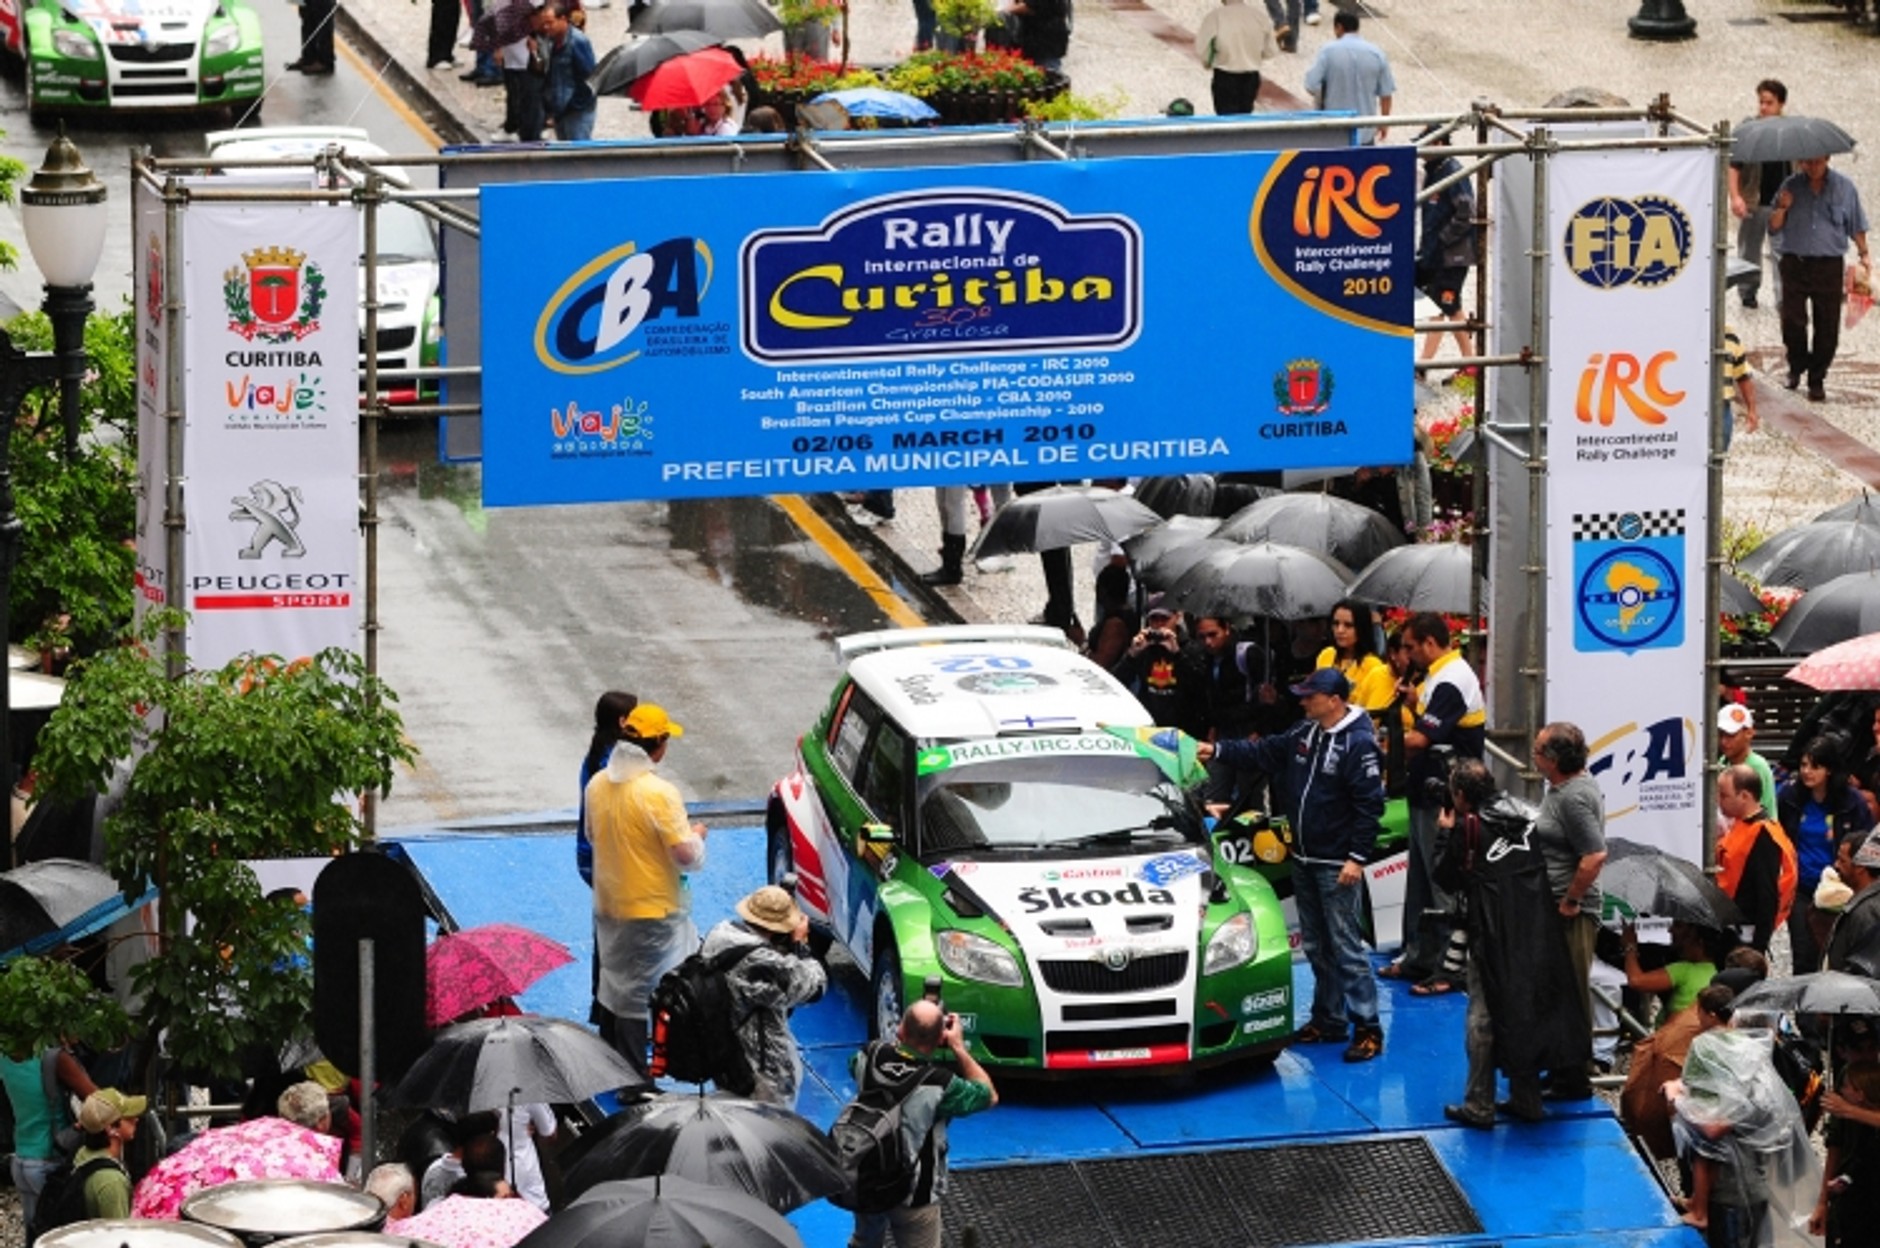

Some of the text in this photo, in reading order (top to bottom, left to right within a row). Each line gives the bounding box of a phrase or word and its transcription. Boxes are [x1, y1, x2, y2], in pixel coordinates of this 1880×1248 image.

[883, 213, 1015, 254] Rally
[1295, 243, 1392, 258] Intercontinental
[865, 254, 1040, 274] Internacional de
[1296, 258, 1391, 273] Rally Challenge
[1343, 275, 1391, 296] 2010
[556, 236, 699, 361] CBA
[769, 264, 1112, 329] Curitiba
[226, 351, 322, 367] CURITIBA
[777, 366, 901, 382] Intercontinental
[906, 364, 945, 378] Rally
[950, 361, 1026, 376] Challenge
[1043, 358, 1069, 371] IRC
[1073, 357, 1110, 370] 2010
[740, 372, 1135, 401] South American Championship FIA-CODASUR 2010
[871, 393, 981, 410] Championship
[998, 391, 1031, 403] CBA
[1036, 391, 1072, 402] 2010
[835, 413, 899, 427] Peugeot
[904, 411, 935, 425] Cup
[940, 404, 1051, 421] Championship
[1068, 403, 1104, 416] 2010
[792, 423, 1095, 453] 02/06 MARCH 2010
[1259, 421, 1347, 439] CURITIBA
[1577, 431, 1678, 446] Intercontinental
[662, 437, 1230, 481] PREFEITURA MUNICIPAL DE CURITIBA
[1577, 447, 1677, 461] Rally Challenge
[193, 574, 349, 590] PEUGEOT
[272, 594, 346, 607] SPORT
[952, 735, 1132, 762] RALLY-IRC.COM
[1220, 838, 1254, 864] 02
[1062, 867, 1122, 880] Castrol
[1018, 882, 1176, 913] Škoda
